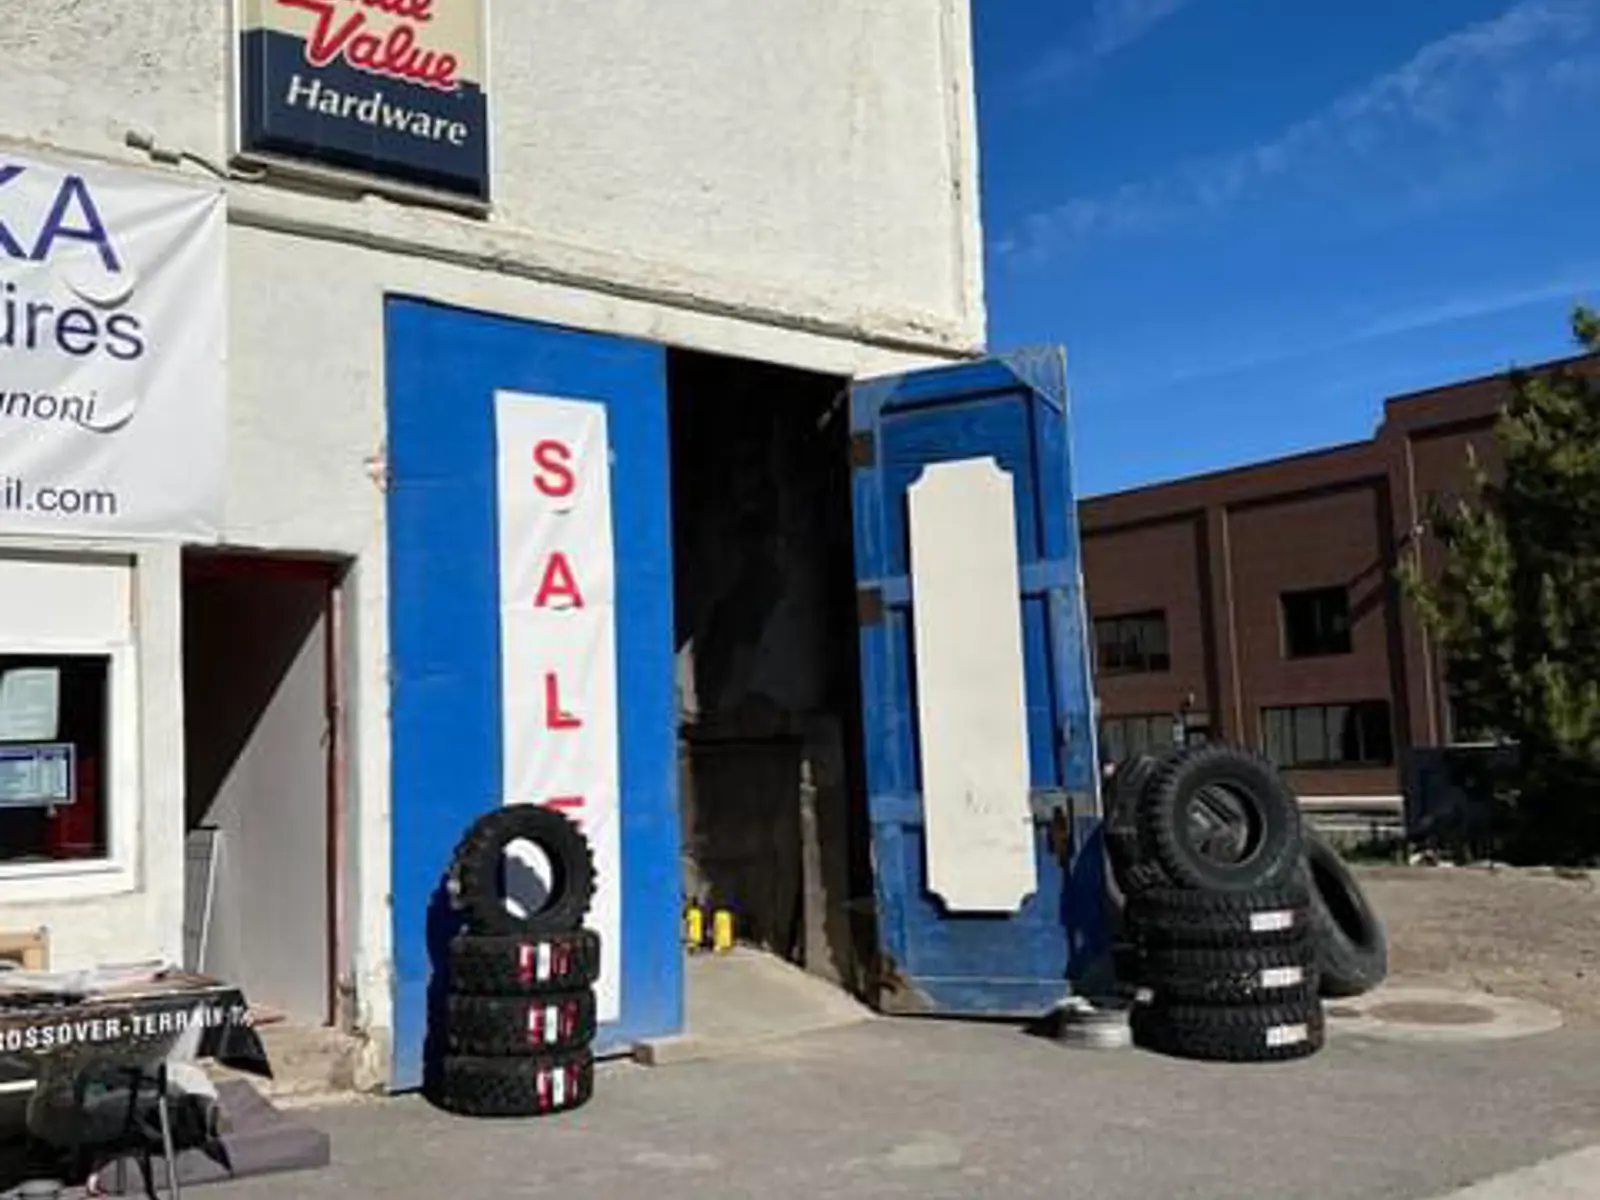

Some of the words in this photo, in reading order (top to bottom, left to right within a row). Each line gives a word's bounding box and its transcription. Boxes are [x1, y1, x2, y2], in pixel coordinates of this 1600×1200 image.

[275, 0, 458, 88] Value
[287, 74, 469, 146] Hardware
[0, 282, 145, 360] ires
[0, 391, 98, 421] noni
